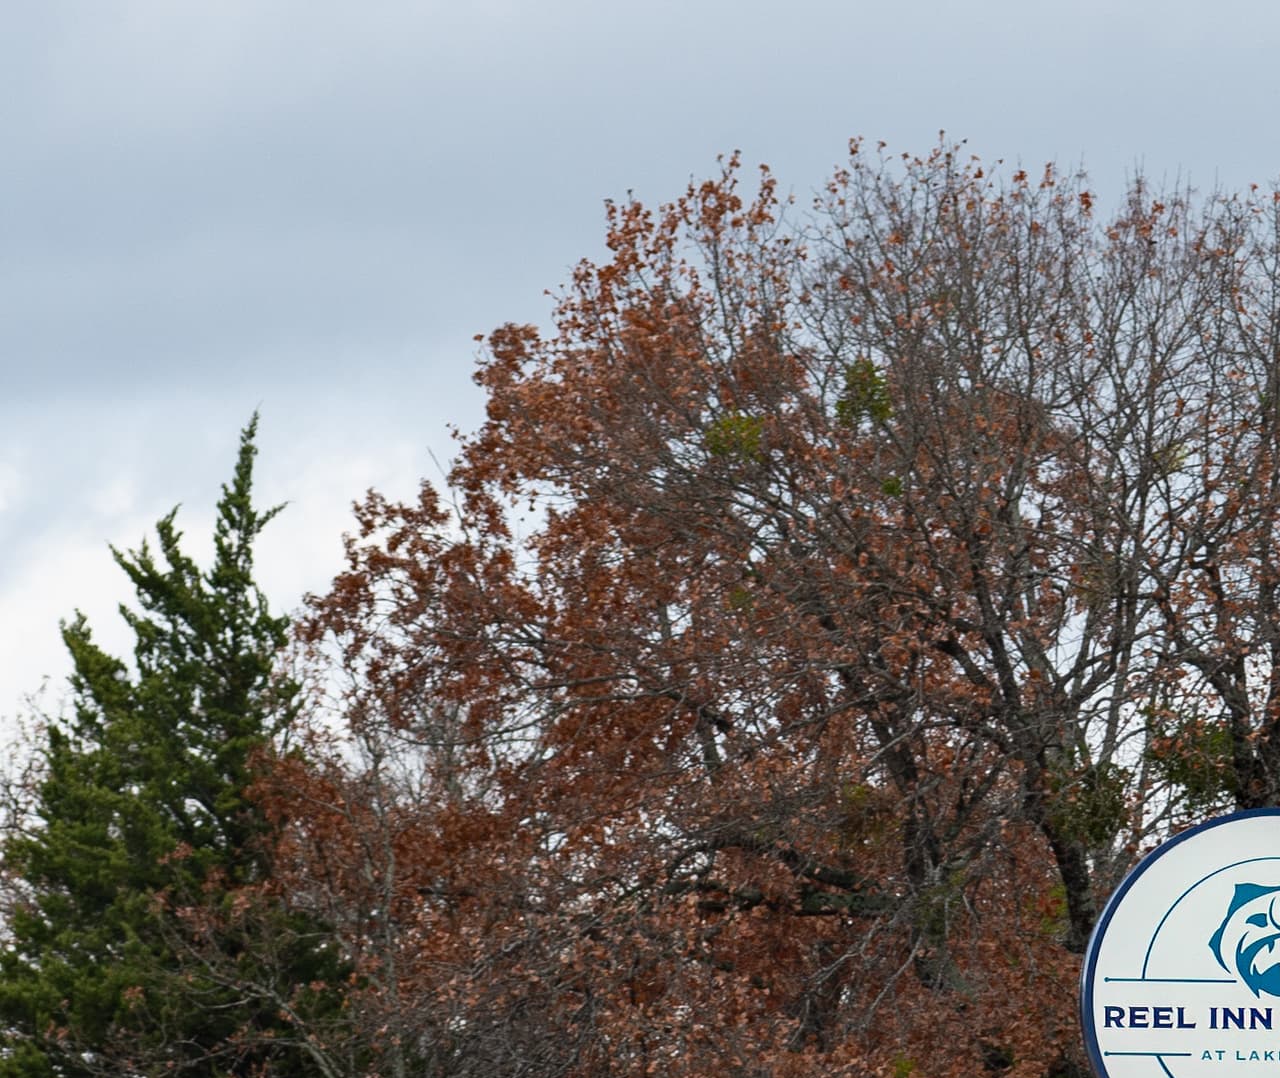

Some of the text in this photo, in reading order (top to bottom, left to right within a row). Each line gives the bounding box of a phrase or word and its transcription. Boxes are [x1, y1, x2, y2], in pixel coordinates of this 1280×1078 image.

[1103, 1005, 1196, 1029] REEL
[1209, 1007, 1273, 1030] INN
[1201, 1050, 1226, 1061] AT
